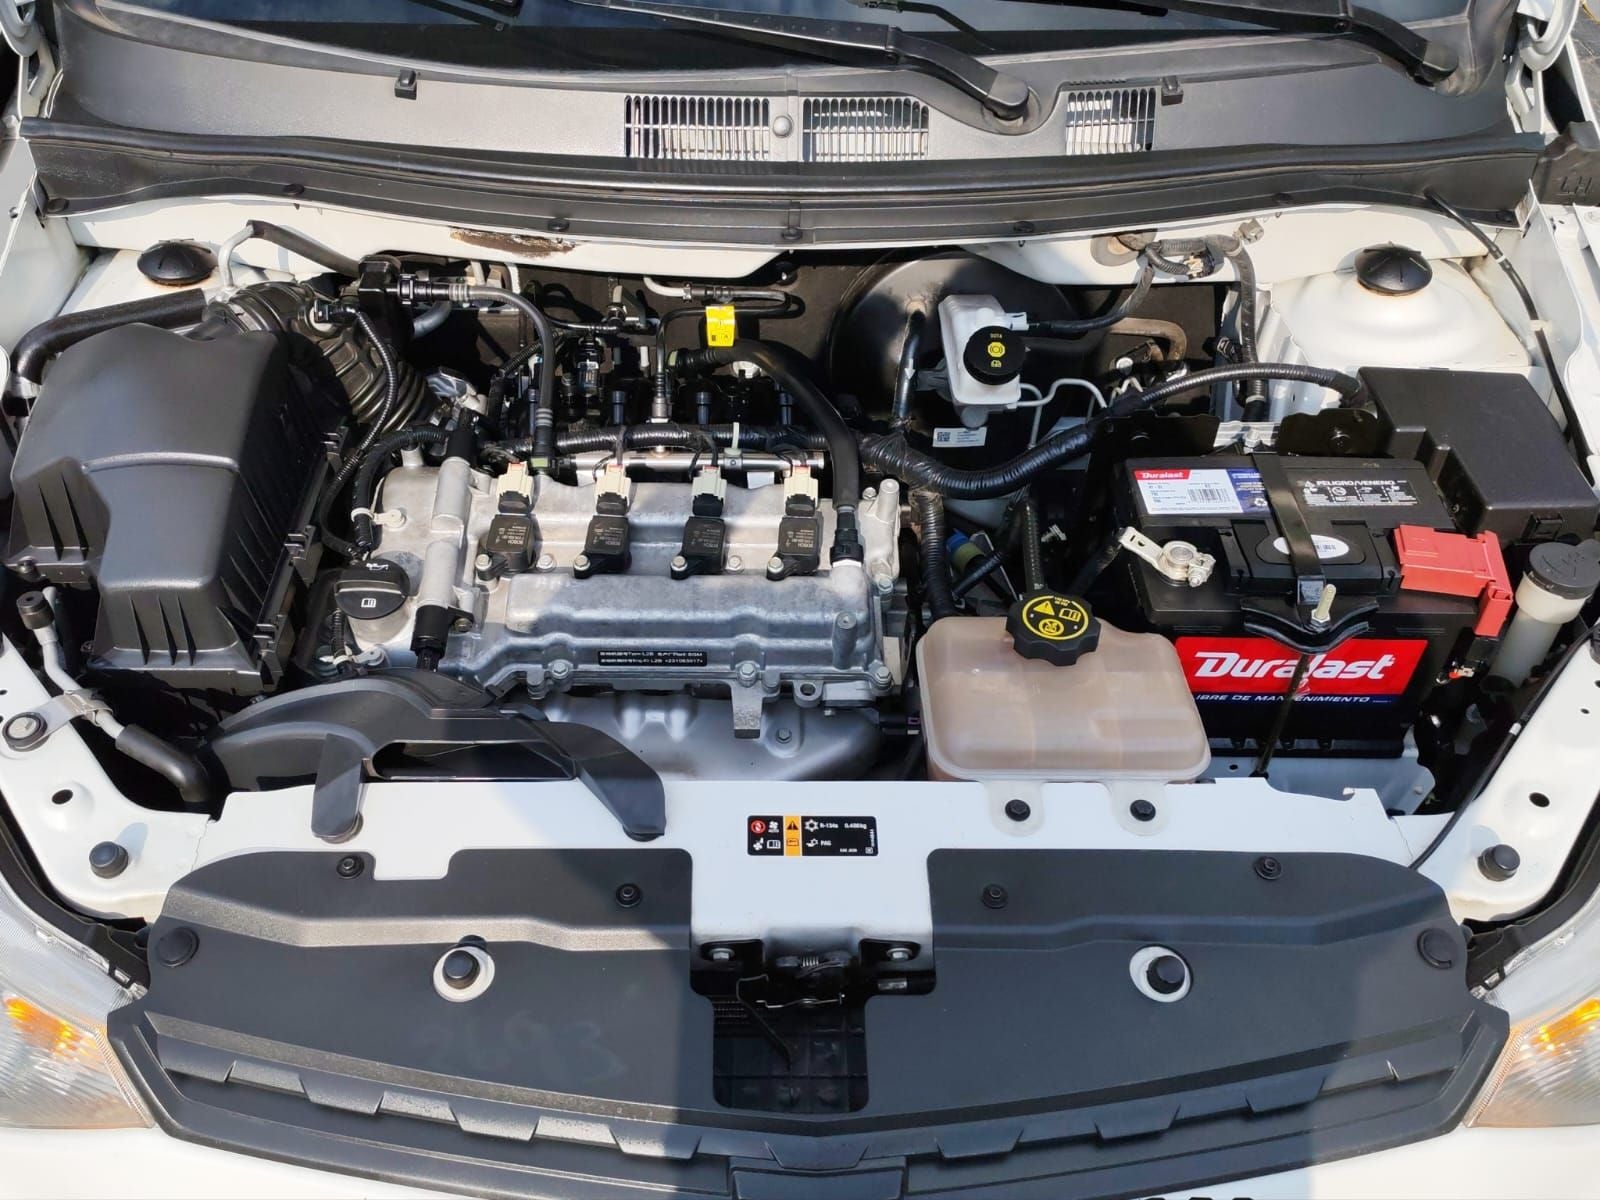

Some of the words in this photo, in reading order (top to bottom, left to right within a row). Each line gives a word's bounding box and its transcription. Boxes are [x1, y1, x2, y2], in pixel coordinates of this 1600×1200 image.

[1141, 471, 1185, 479] Duralast
[1194, 651, 1396, 680] Duralast
[1254, 695, 1371, 703] MANENIMIENTO
